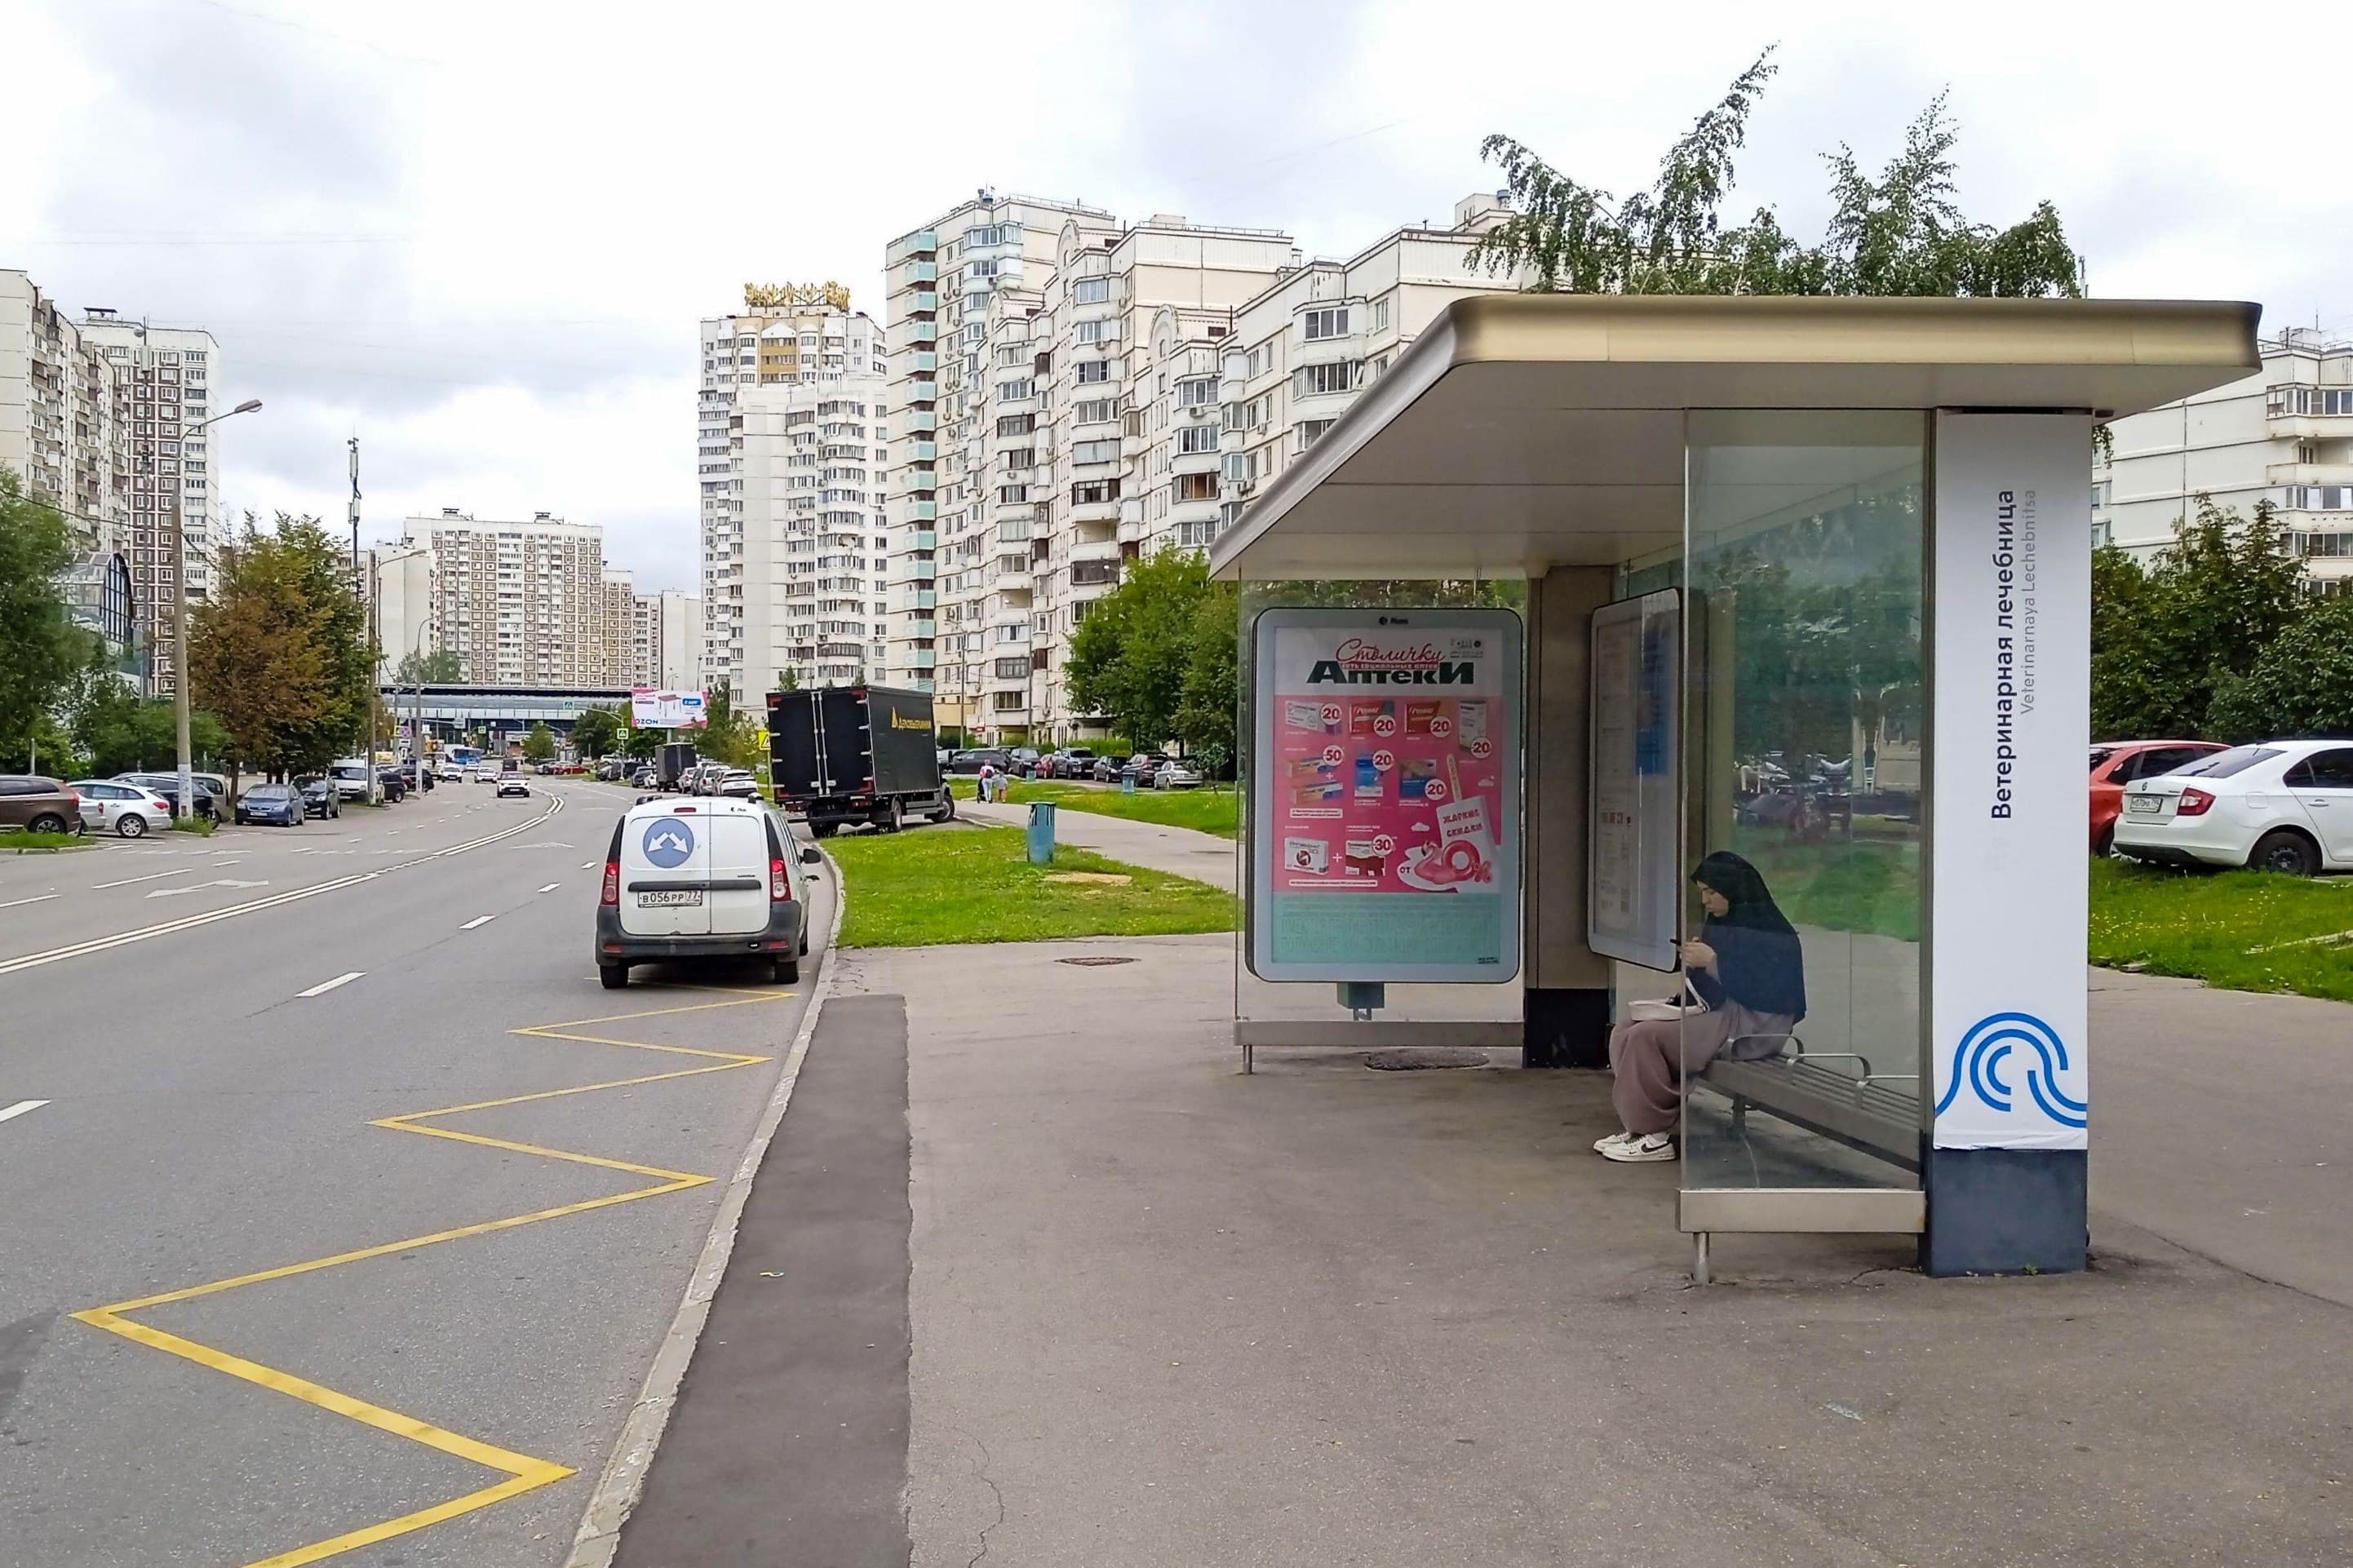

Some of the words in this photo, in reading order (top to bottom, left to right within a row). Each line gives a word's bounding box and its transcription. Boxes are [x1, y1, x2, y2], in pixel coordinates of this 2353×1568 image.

[1992, 490, 2018, 630] лечебница
[2021, 489, 2036, 592] Lechebnitsa
[1336, 638, 1446, 662] Столички
[2020, 597, 2038, 715] Veterinarnaya
[1991, 636, 2018, 819] Ветеринарная
